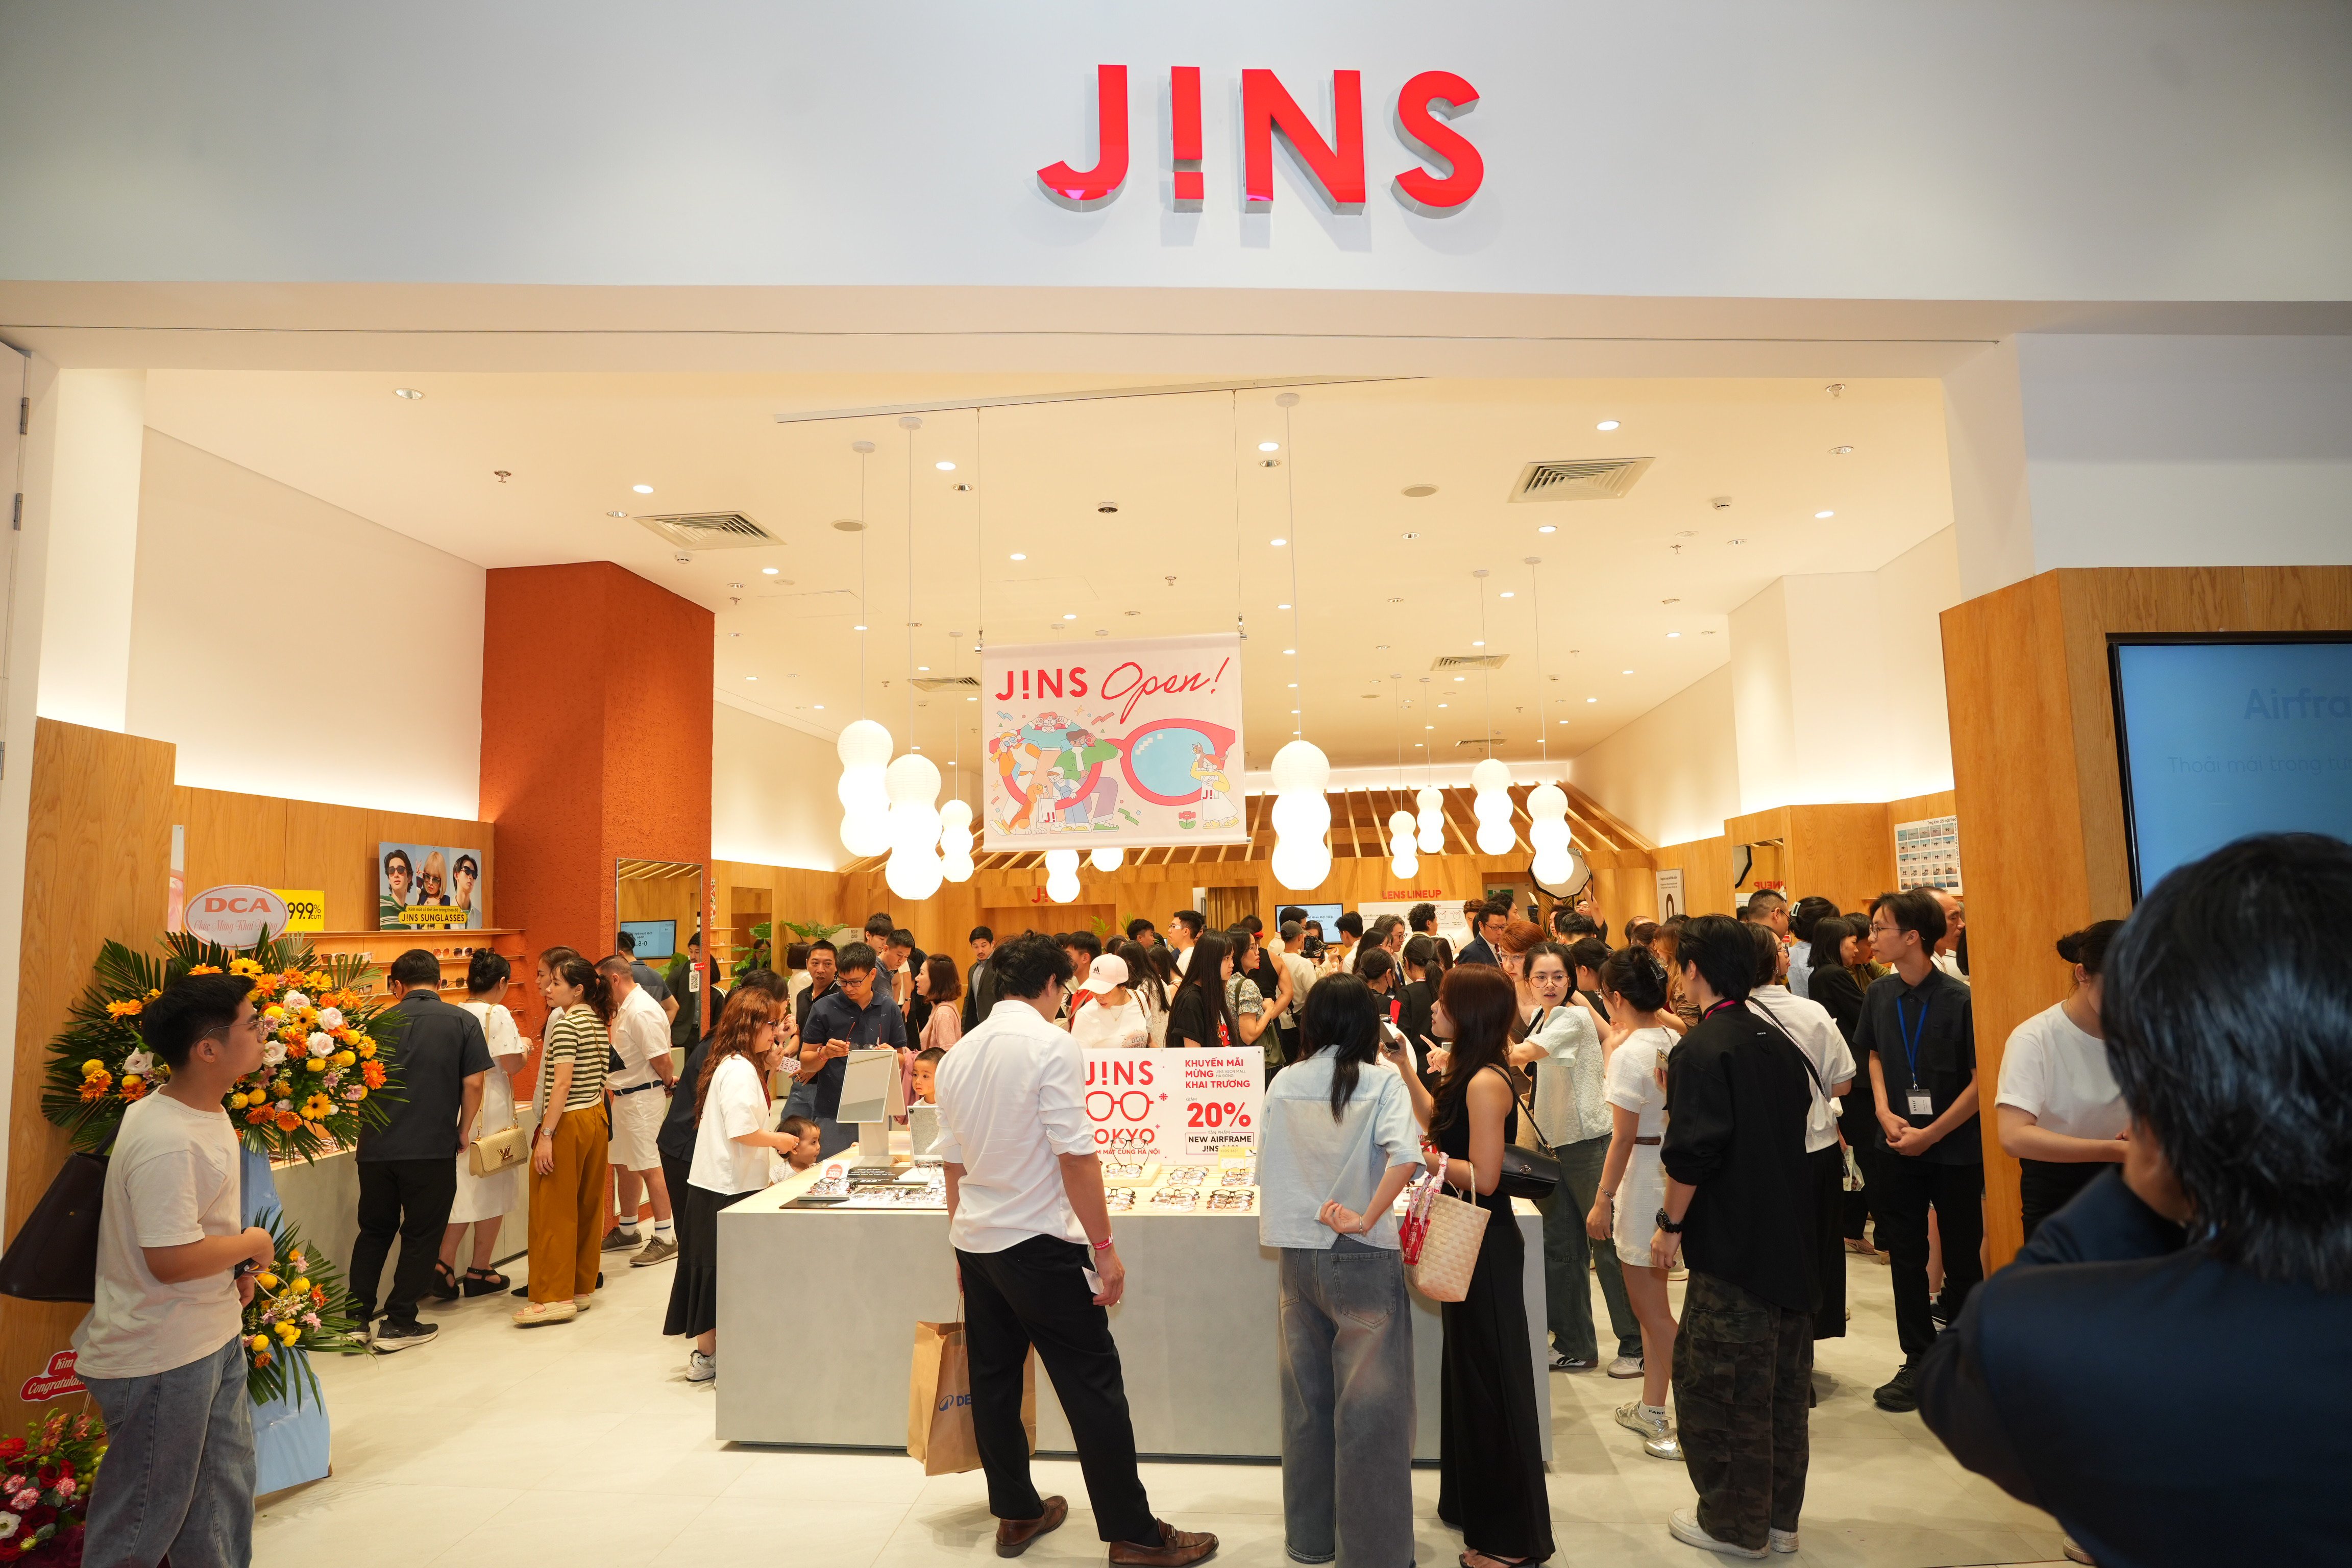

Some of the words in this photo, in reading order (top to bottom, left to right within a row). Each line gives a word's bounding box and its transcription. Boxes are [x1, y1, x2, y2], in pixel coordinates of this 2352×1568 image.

[1101, 657, 1230, 725] Open!
[2167, 756, 2220, 773] Thoải
[2227, 756, 2263, 772] mái
[2270, 757, 2322, 775] trong
[1382, 890, 1406, 899] LENS
[1407, 890, 1442, 899] LINEUP
[204, 897, 272, 913] DCA
[421, 914, 464, 922] SUNGLASSES
[236, 920, 254, 931] Khai
[1185, 1057, 1223, 1067] KHUYẾN
[1227, 1057, 1243, 1067] MÃI
[1185, 1069, 1214, 1077] MỪNG
[1210, 1079, 1250, 1088] TRƯƠNG
[1187, 1101, 1251, 1128] 20%
[1094, 1128, 1155, 1144] OKYO
[55, 1357, 74, 1370] Kim
